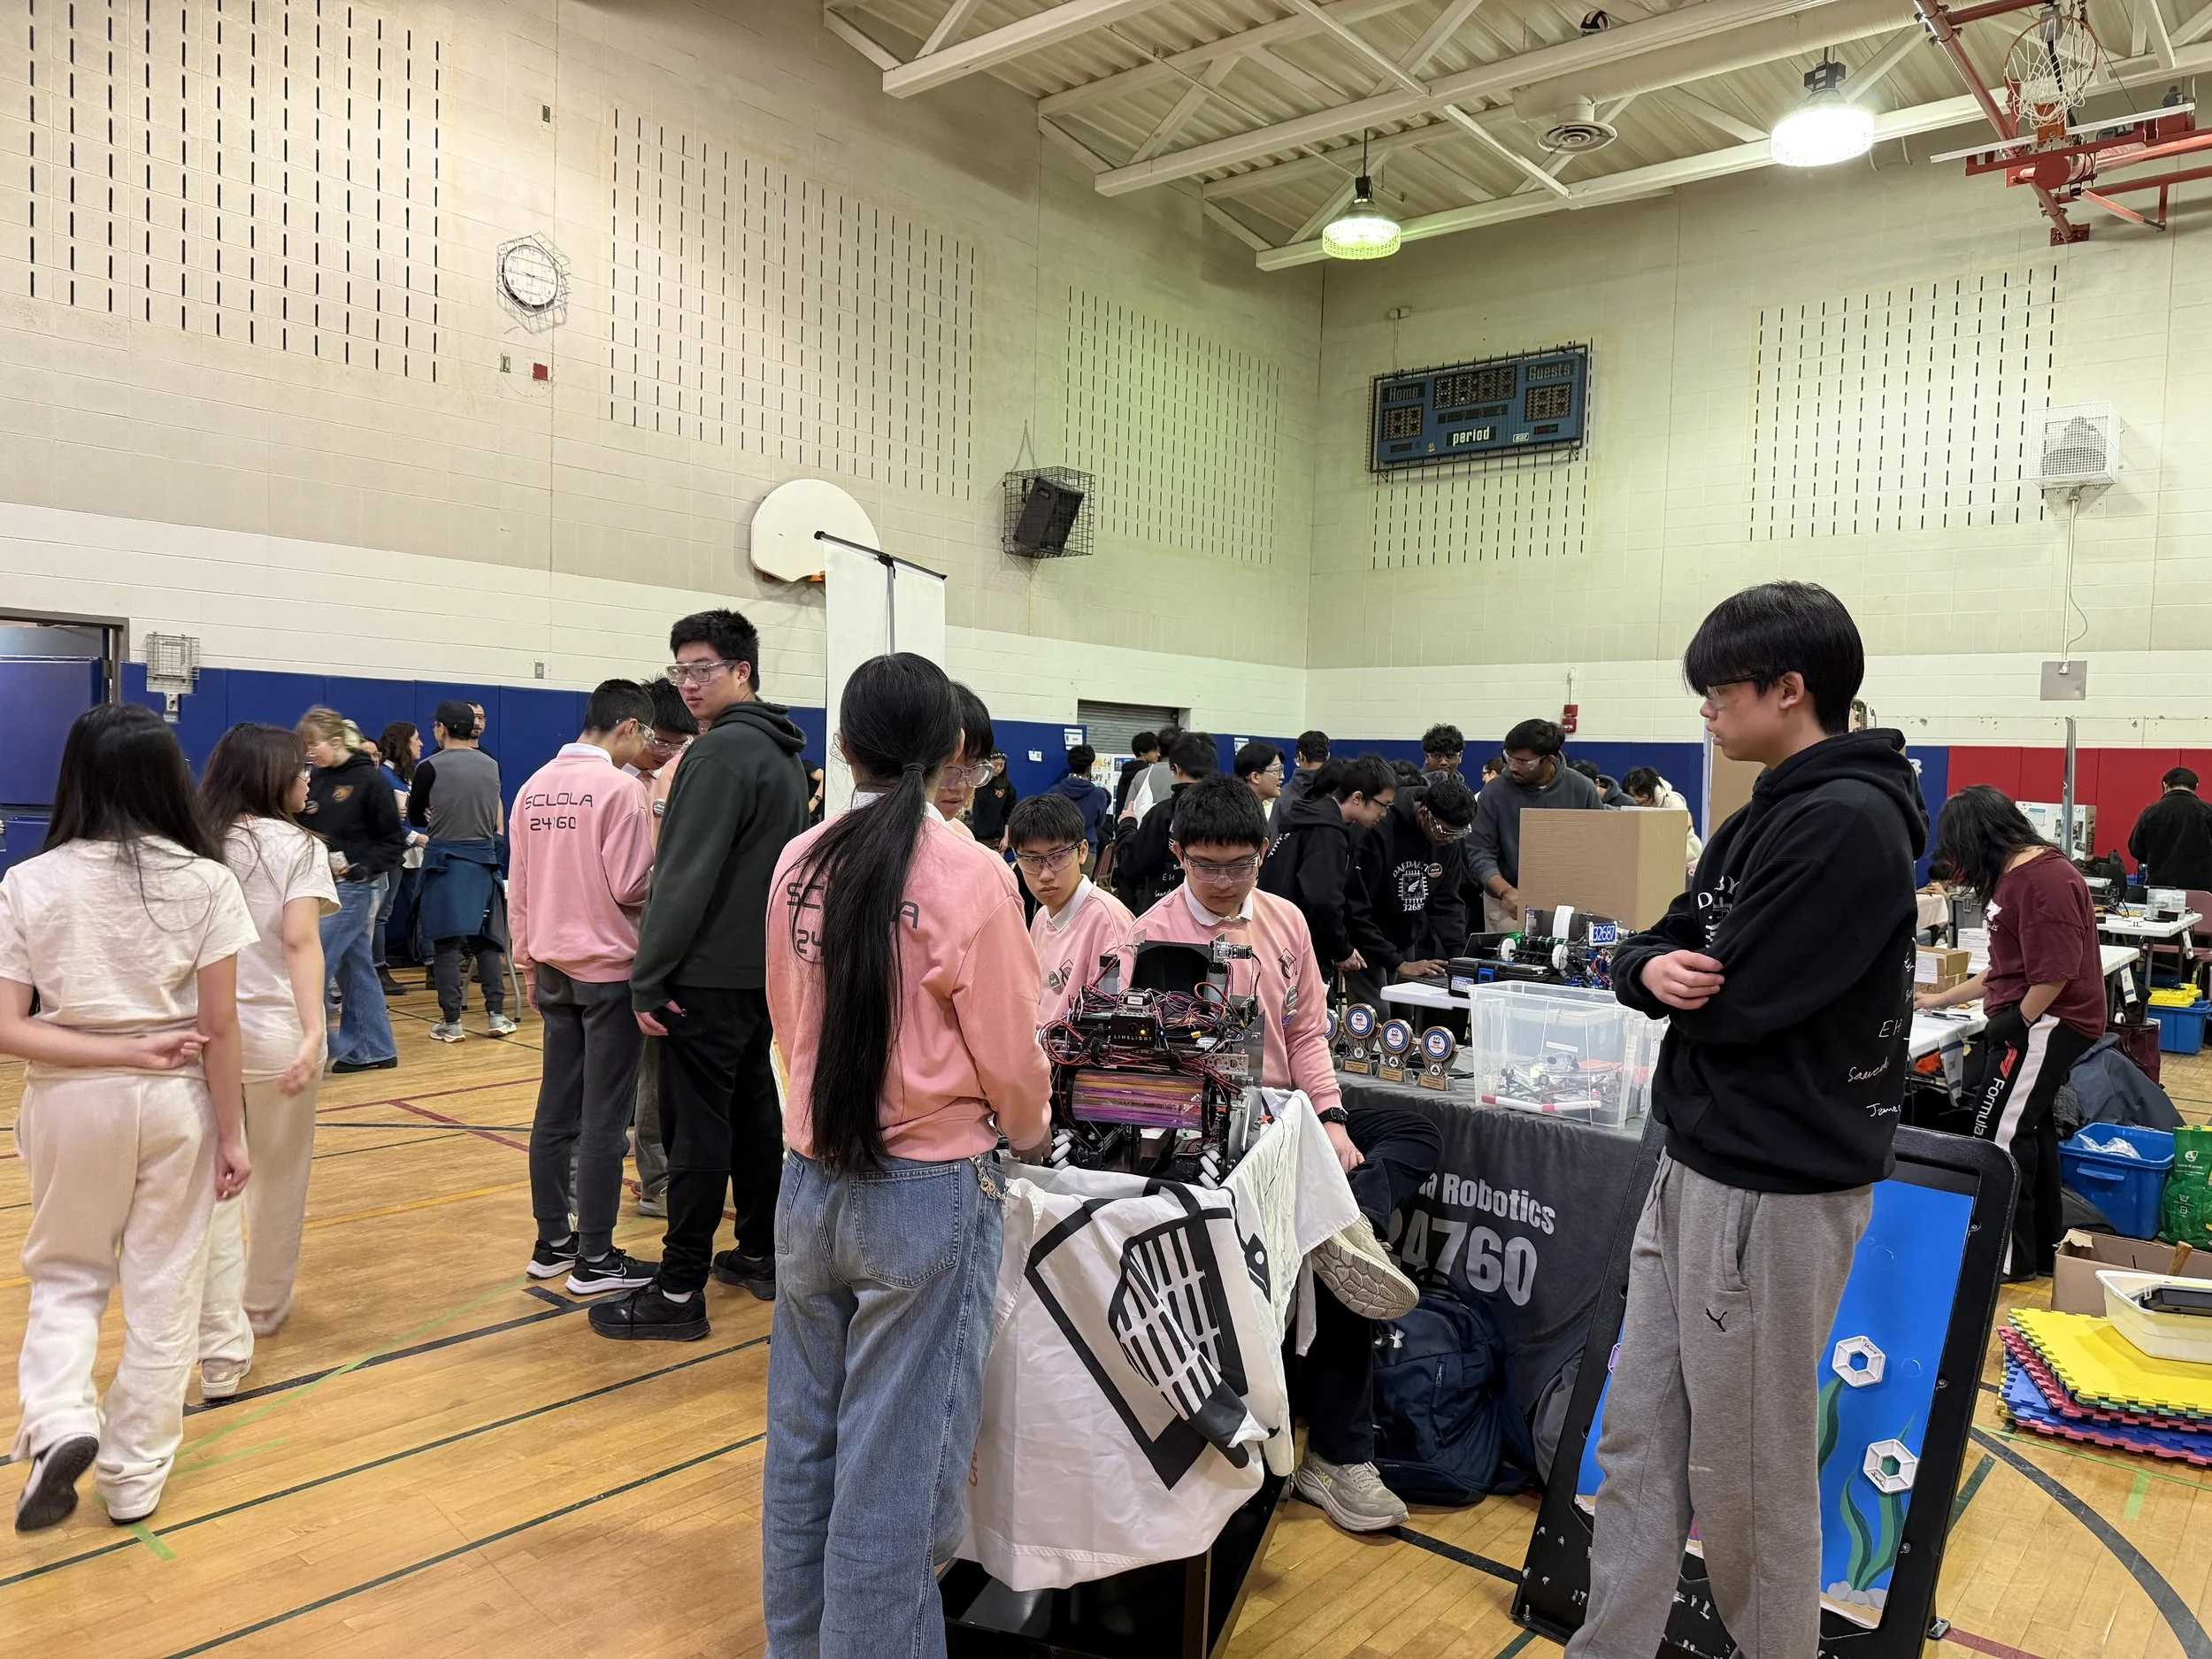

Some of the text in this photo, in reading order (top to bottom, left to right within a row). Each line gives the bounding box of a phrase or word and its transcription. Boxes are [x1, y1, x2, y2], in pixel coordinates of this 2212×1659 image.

[1528, 363, 1571, 381] Guests
[1388, 387, 1419, 403] Home
[1452, 426, 1490, 447] period
[525, 793, 593, 810] SCLOLA
[530, 816, 577, 832] 2460
[1593, 925, 1616, 941] 32687
[1973, 1077, 2006, 1136] Formula
[1441, 1172, 1556, 1235] Robotics
